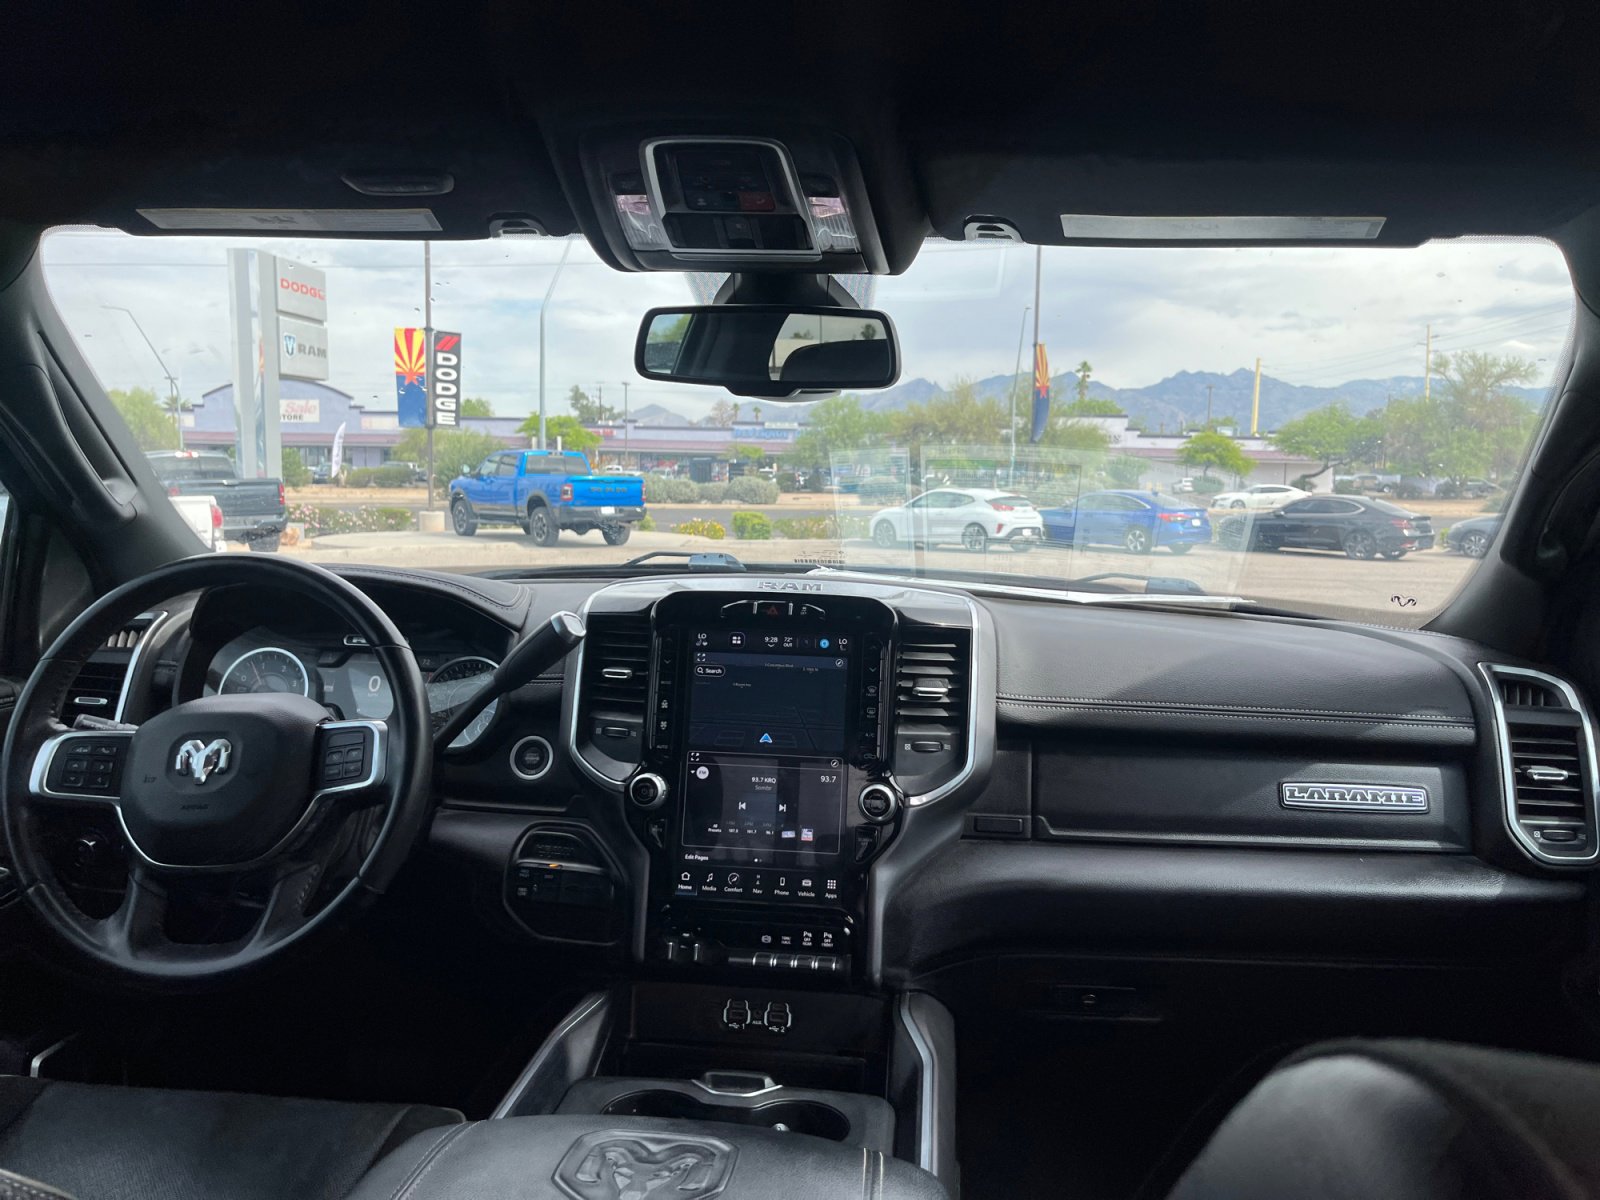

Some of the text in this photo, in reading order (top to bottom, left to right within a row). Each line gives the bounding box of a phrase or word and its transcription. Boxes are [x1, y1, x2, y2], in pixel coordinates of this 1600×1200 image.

[297, 343, 327, 359] RAM
[435, 351, 458, 426] DODGE
[758, 581, 823, 591] RAM
[368, 675, 381, 692] 0
[820, 775, 836, 783] 93.7
[1285, 786, 1426, 806] LARAMIE
